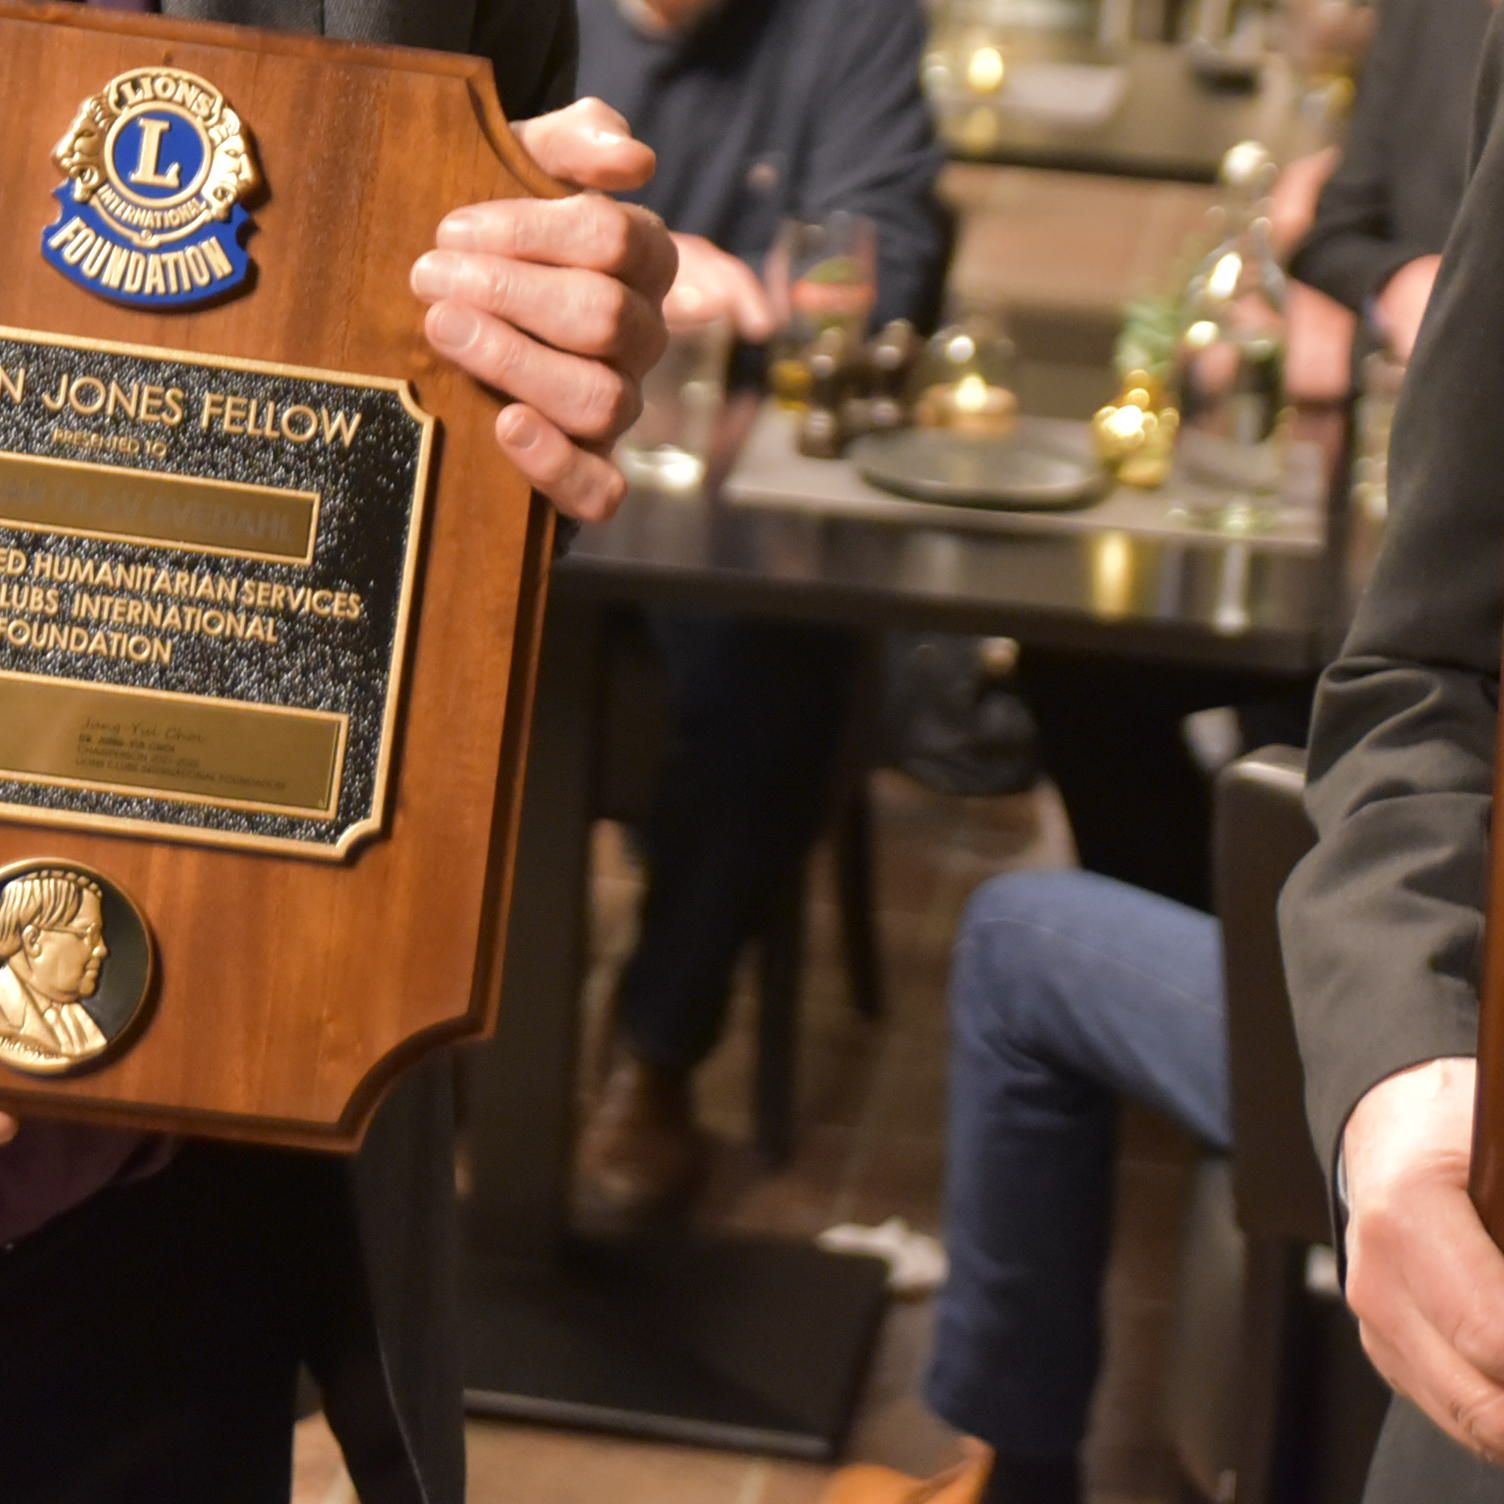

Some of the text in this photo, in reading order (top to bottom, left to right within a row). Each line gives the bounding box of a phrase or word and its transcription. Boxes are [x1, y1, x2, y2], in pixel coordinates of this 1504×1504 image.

[119, 76, 215, 117] LIONS
[129, 118, 179, 188] L
[97, 184, 207, 229] INTERNATIONAL
[49, 216, 233, 295] FOUNDATION
[42, 373, 184, 426] JONES
[200, 390, 362, 447] FELLOW
[52, 427, 168, 459] PRESENTED TO
[33, 552, 238, 603] HUMANITARIAN
[242, 578, 362, 621] SERVICES
[72, 591, 278, 643] INTERNATIONAL
